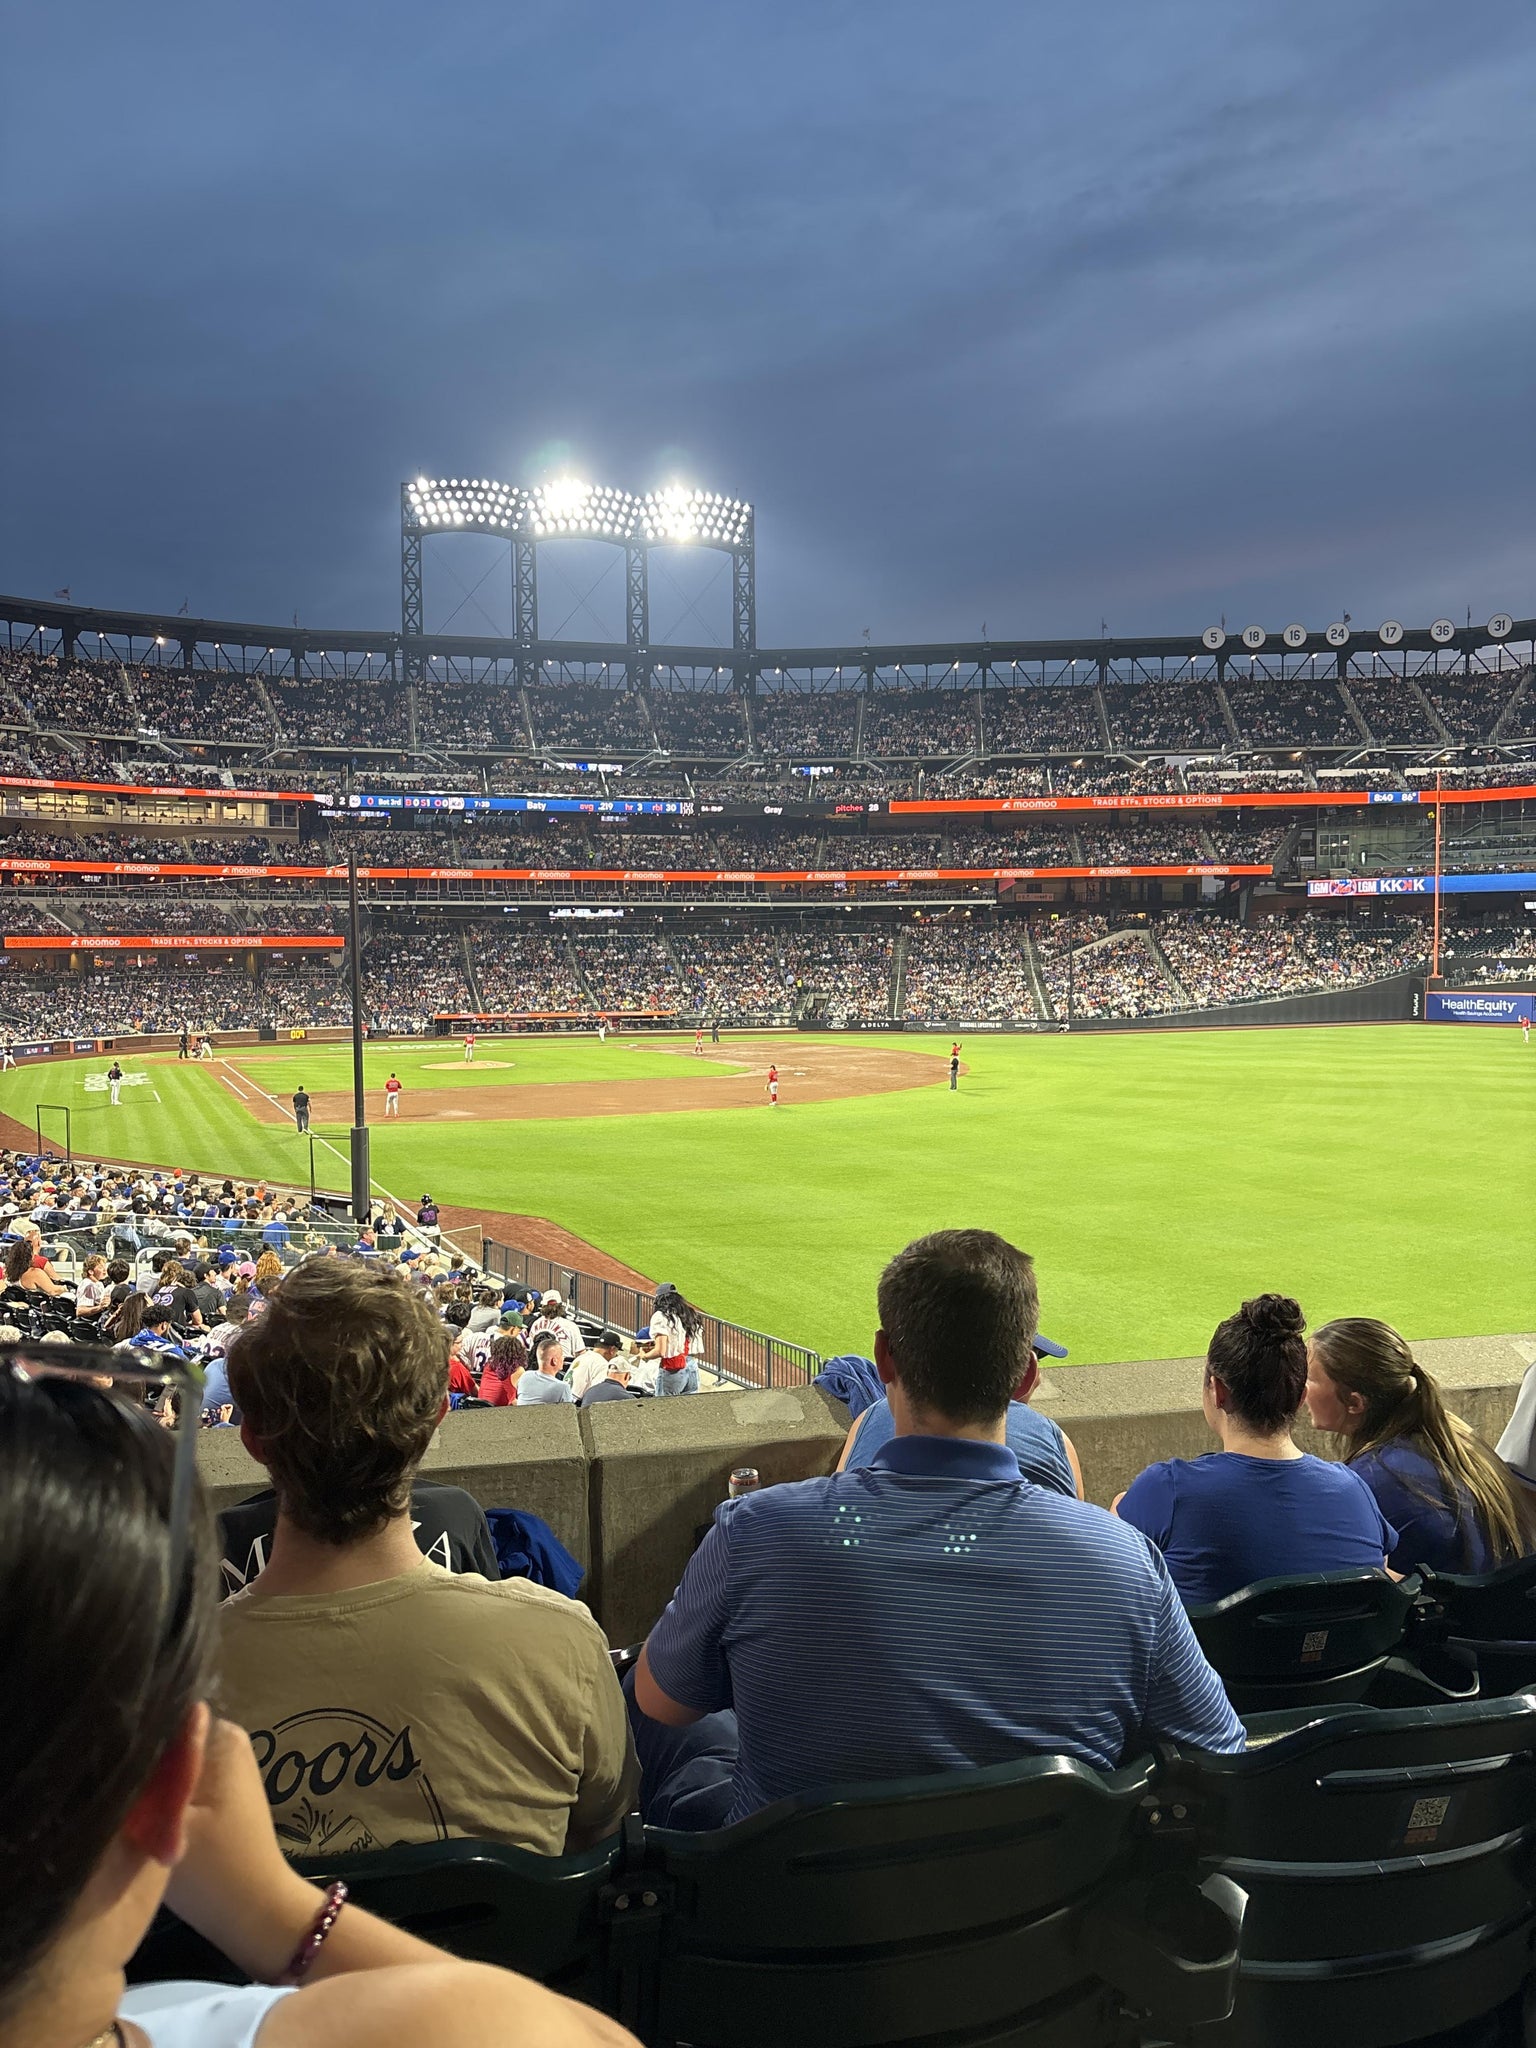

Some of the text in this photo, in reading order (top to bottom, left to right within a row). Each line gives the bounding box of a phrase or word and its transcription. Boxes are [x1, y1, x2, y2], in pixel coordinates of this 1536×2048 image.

[1435, 625, 1450, 636] 36
[1494, 620, 1506, 632] 31
[1210, 632, 1218, 643] 5
[1249, 631, 1260, 642] 18
[1289, 629, 1301, 641] 16
[1330, 628, 1345, 640] 24
[1386, 627, 1397, 638] 17
[339, 796, 346, 805] 2
[390, 798, 402, 806] 3rd
[1092, 798, 1118, 807] TRADE
[1120, 798, 1142, 806] ETFs,
[1143, 797, 1176, 806] STOCKS
[1185, 796, 1223, 805] OPTIONS
[1373, 793, 1394, 802] 8:40
[526, 800, 546, 812] Baty
[579, 802, 677, 812] avg .219 hr 3 rbi 30
[835, 803, 880, 814] pitches 28
[1013, 800, 1057, 809] moomoo
[763, 805, 783, 815] Gray
[11, 861, 51, 870] moomoo
[123, 865, 161, 873] moomoo
[1195, 866, 1230, 874] moomoo
[231, 867, 268, 875] moomoo
[537, 871, 571, 879] moomoo
[814, 872, 847, 880] moomoo
[906, 871, 939, 879] moomoo
[1001, 869, 1035, 877] moomoo
[1097, 867, 1132, 875] moomoo
[1309, 882, 1329, 893] LGM
[1357, 880, 1377, 892] LGM
[81, 938, 121, 946] moomoo
[1441, 998, 1515, 1013] HealthEquity
[534, 1319, 569, 1341] MARTINEZ
